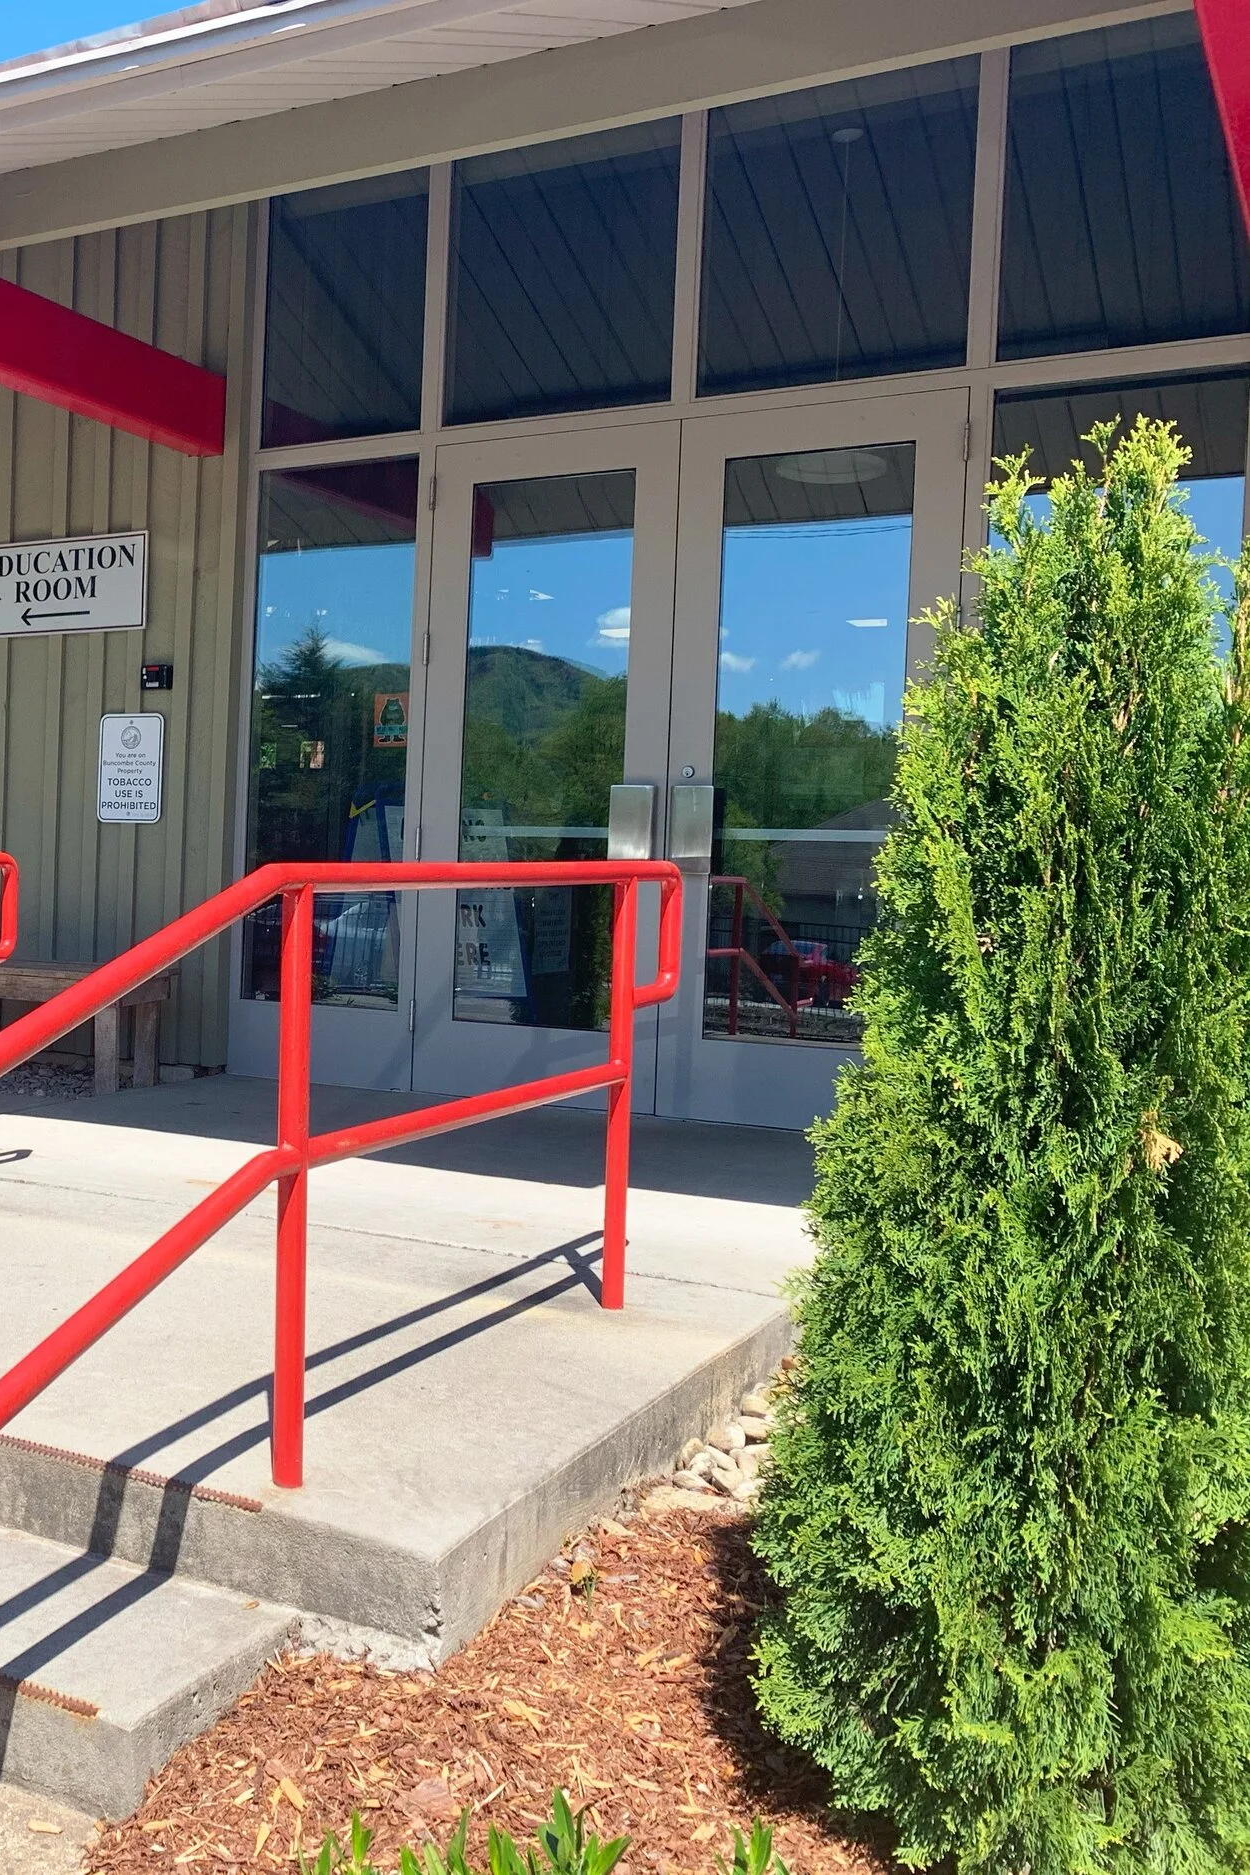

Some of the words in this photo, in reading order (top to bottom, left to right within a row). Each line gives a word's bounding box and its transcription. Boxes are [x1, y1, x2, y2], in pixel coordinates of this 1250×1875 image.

[14, 575, 98, 603] ROOM
[107, 778, 152, 786] TOBACCO
[114, 789, 133, 798] USE
[135, 789, 144, 798] IS
[101, 801, 157, 810] PROHIBITED
[457, 942, 491, 966] ERE
